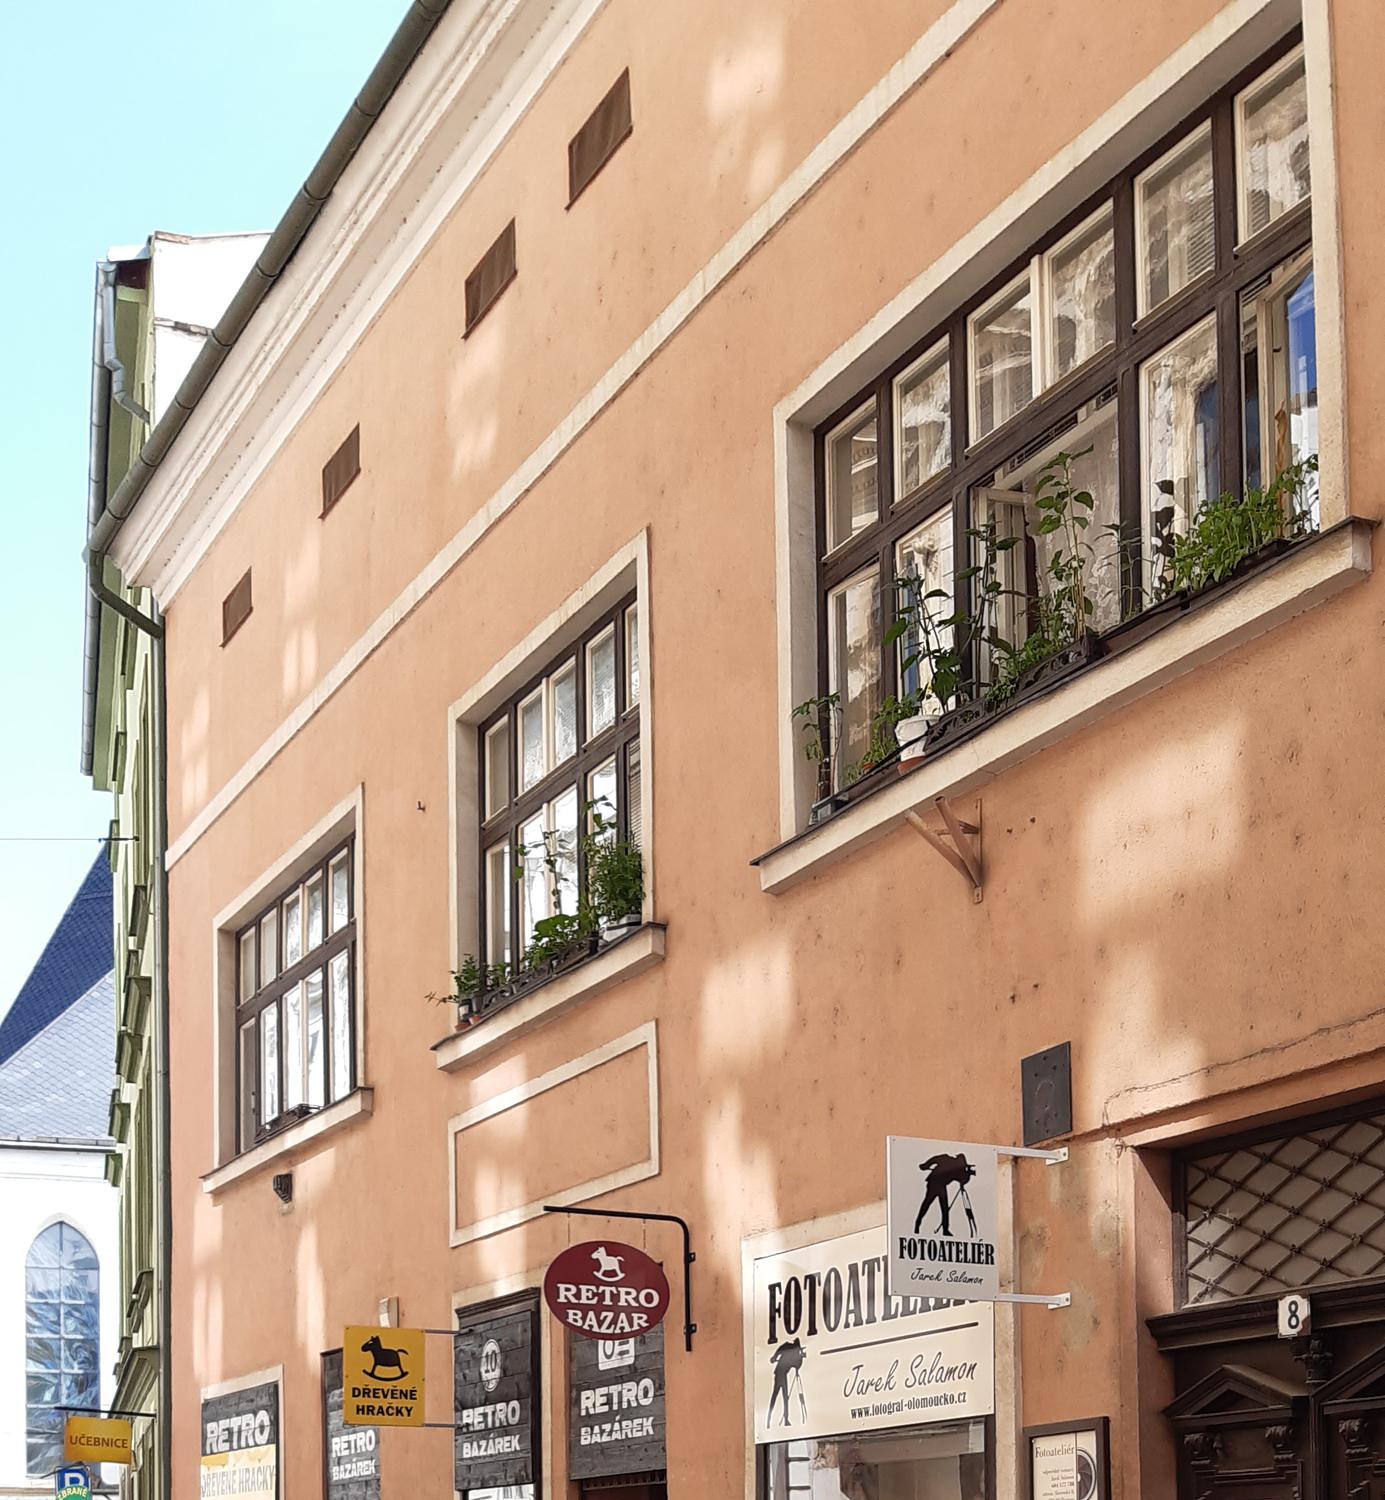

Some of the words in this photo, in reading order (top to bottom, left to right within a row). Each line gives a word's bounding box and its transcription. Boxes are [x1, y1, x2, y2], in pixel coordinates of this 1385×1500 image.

[898, 1237, 995, 1266] FOTOATELIÉR
[910, 1267, 944, 1282] Jarek
[946, 1270, 984, 1286] Salamon
[557, 1283, 660, 1308] RETRO
[767, 1254, 978, 1345] FOTOAT
[566, 1309, 650, 1335] BAZAR
[1288, 1300, 1300, 1330] 8
[843, 1359, 899, 1398] Jarek
[904, 1351, 978, 1389] Salamon
[351, 1384, 418, 1401] DŘEVĚNÉ
[580, 1378, 655, 1417] RETRO
[356, 1402, 414, 1418] HRAČKY
[462, 1400, 520, 1432] RETRO
[69, 1433, 129, 1449] UČEBNICE
[205, 1410, 271, 1455] RETRO
[331, 1430, 376, 1458] RETRO
[580, 1415, 655, 1446] BAZÁREK
[462, 1432, 521, 1459] BAZÁREK
[1035, 1444, 1075, 1459] Fotoateliér
[332, 1458, 376, 1481] BAZÁREK
